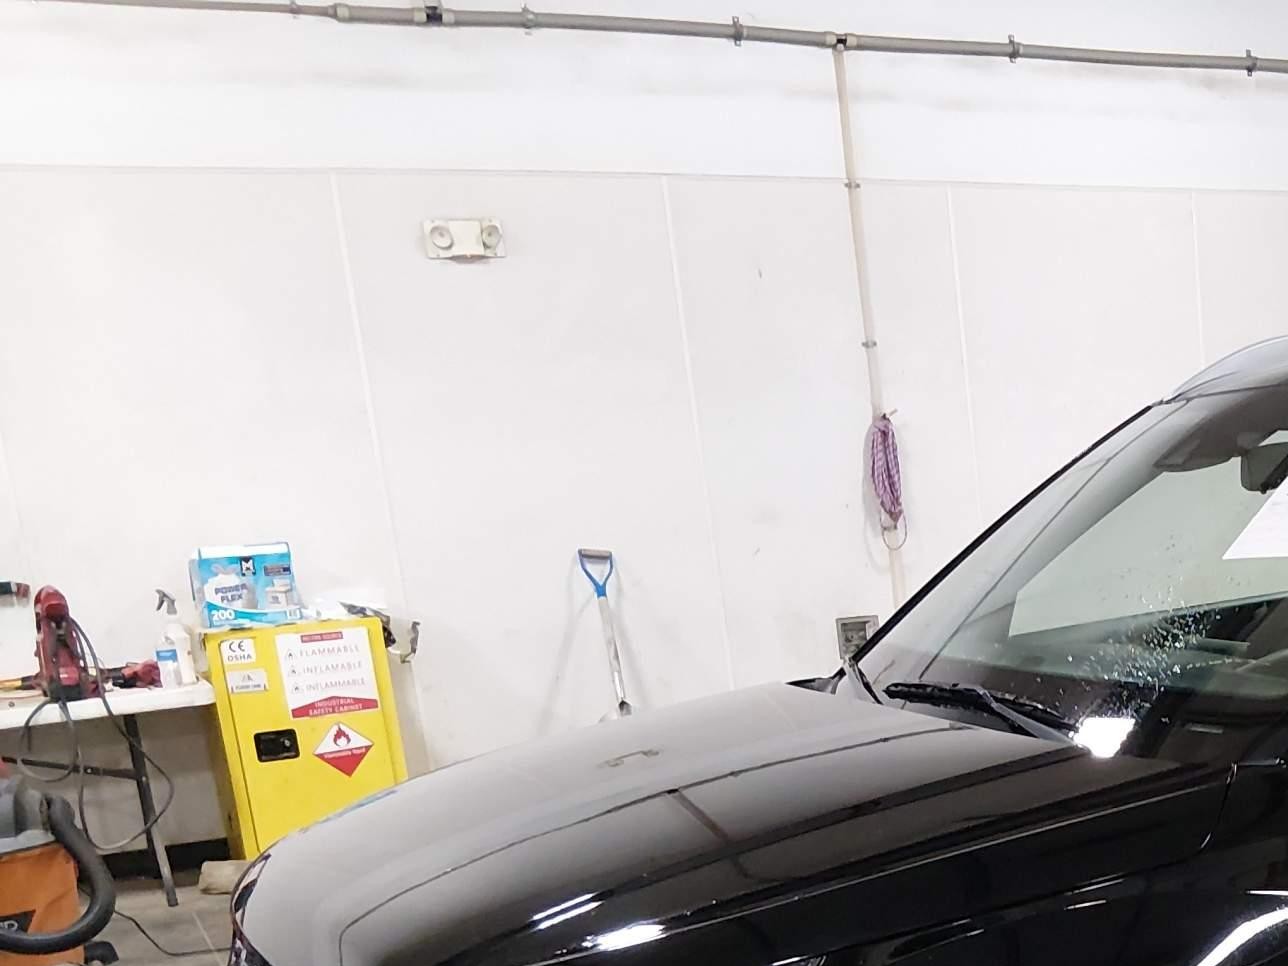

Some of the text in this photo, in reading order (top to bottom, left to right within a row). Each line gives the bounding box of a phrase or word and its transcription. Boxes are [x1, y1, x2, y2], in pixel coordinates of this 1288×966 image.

[221, 593, 243, 603] FLEX
[211, 609, 235, 620] 200
[300, 644, 360, 657] FLAMMABLE
[227, 653, 253, 662] OSHA
[303, 660, 362, 674] INFLAMABLE
[305, 677, 366, 692] INFLAMMABLE
[308, 703, 363, 716] SAFETY CABINET
